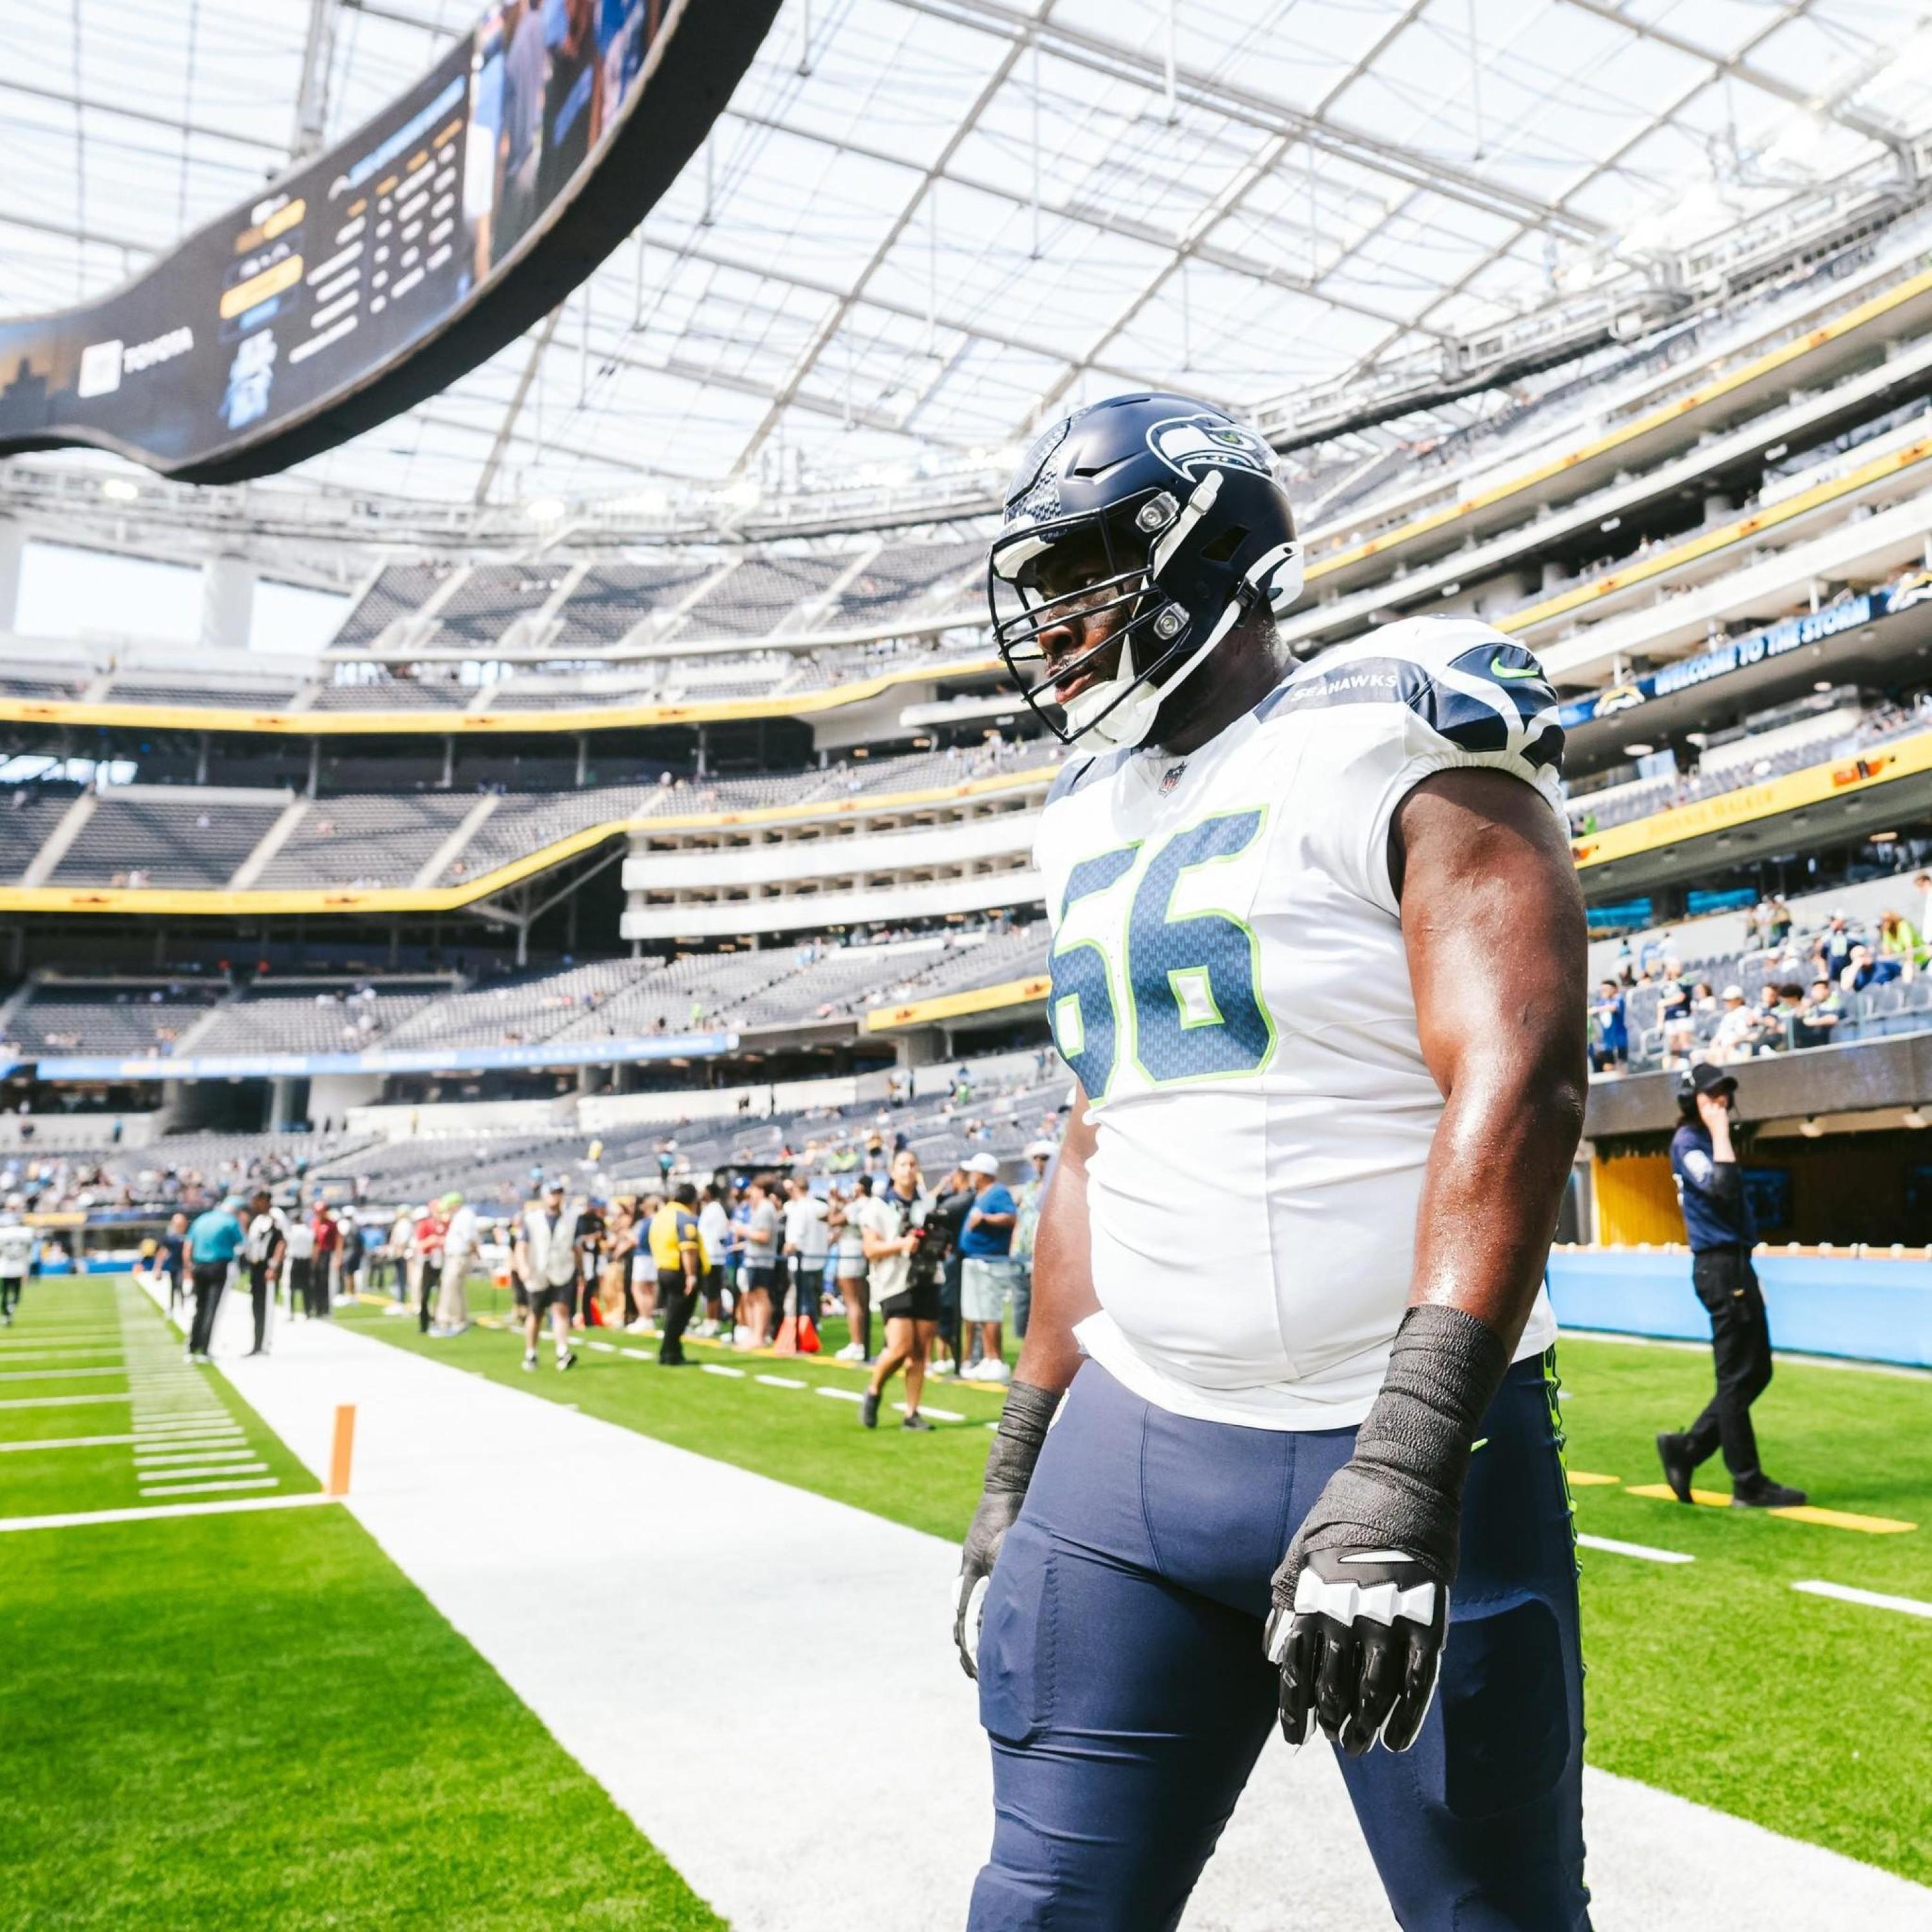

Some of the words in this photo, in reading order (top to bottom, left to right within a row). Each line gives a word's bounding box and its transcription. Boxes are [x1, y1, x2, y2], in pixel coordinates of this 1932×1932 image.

[1739, 636, 1765, 666] TO
[1801, 594, 1870, 644] STORM
[1289, 674, 1398, 702] SEAHAWKS
[1047, 804, 1278, 1108] 66
